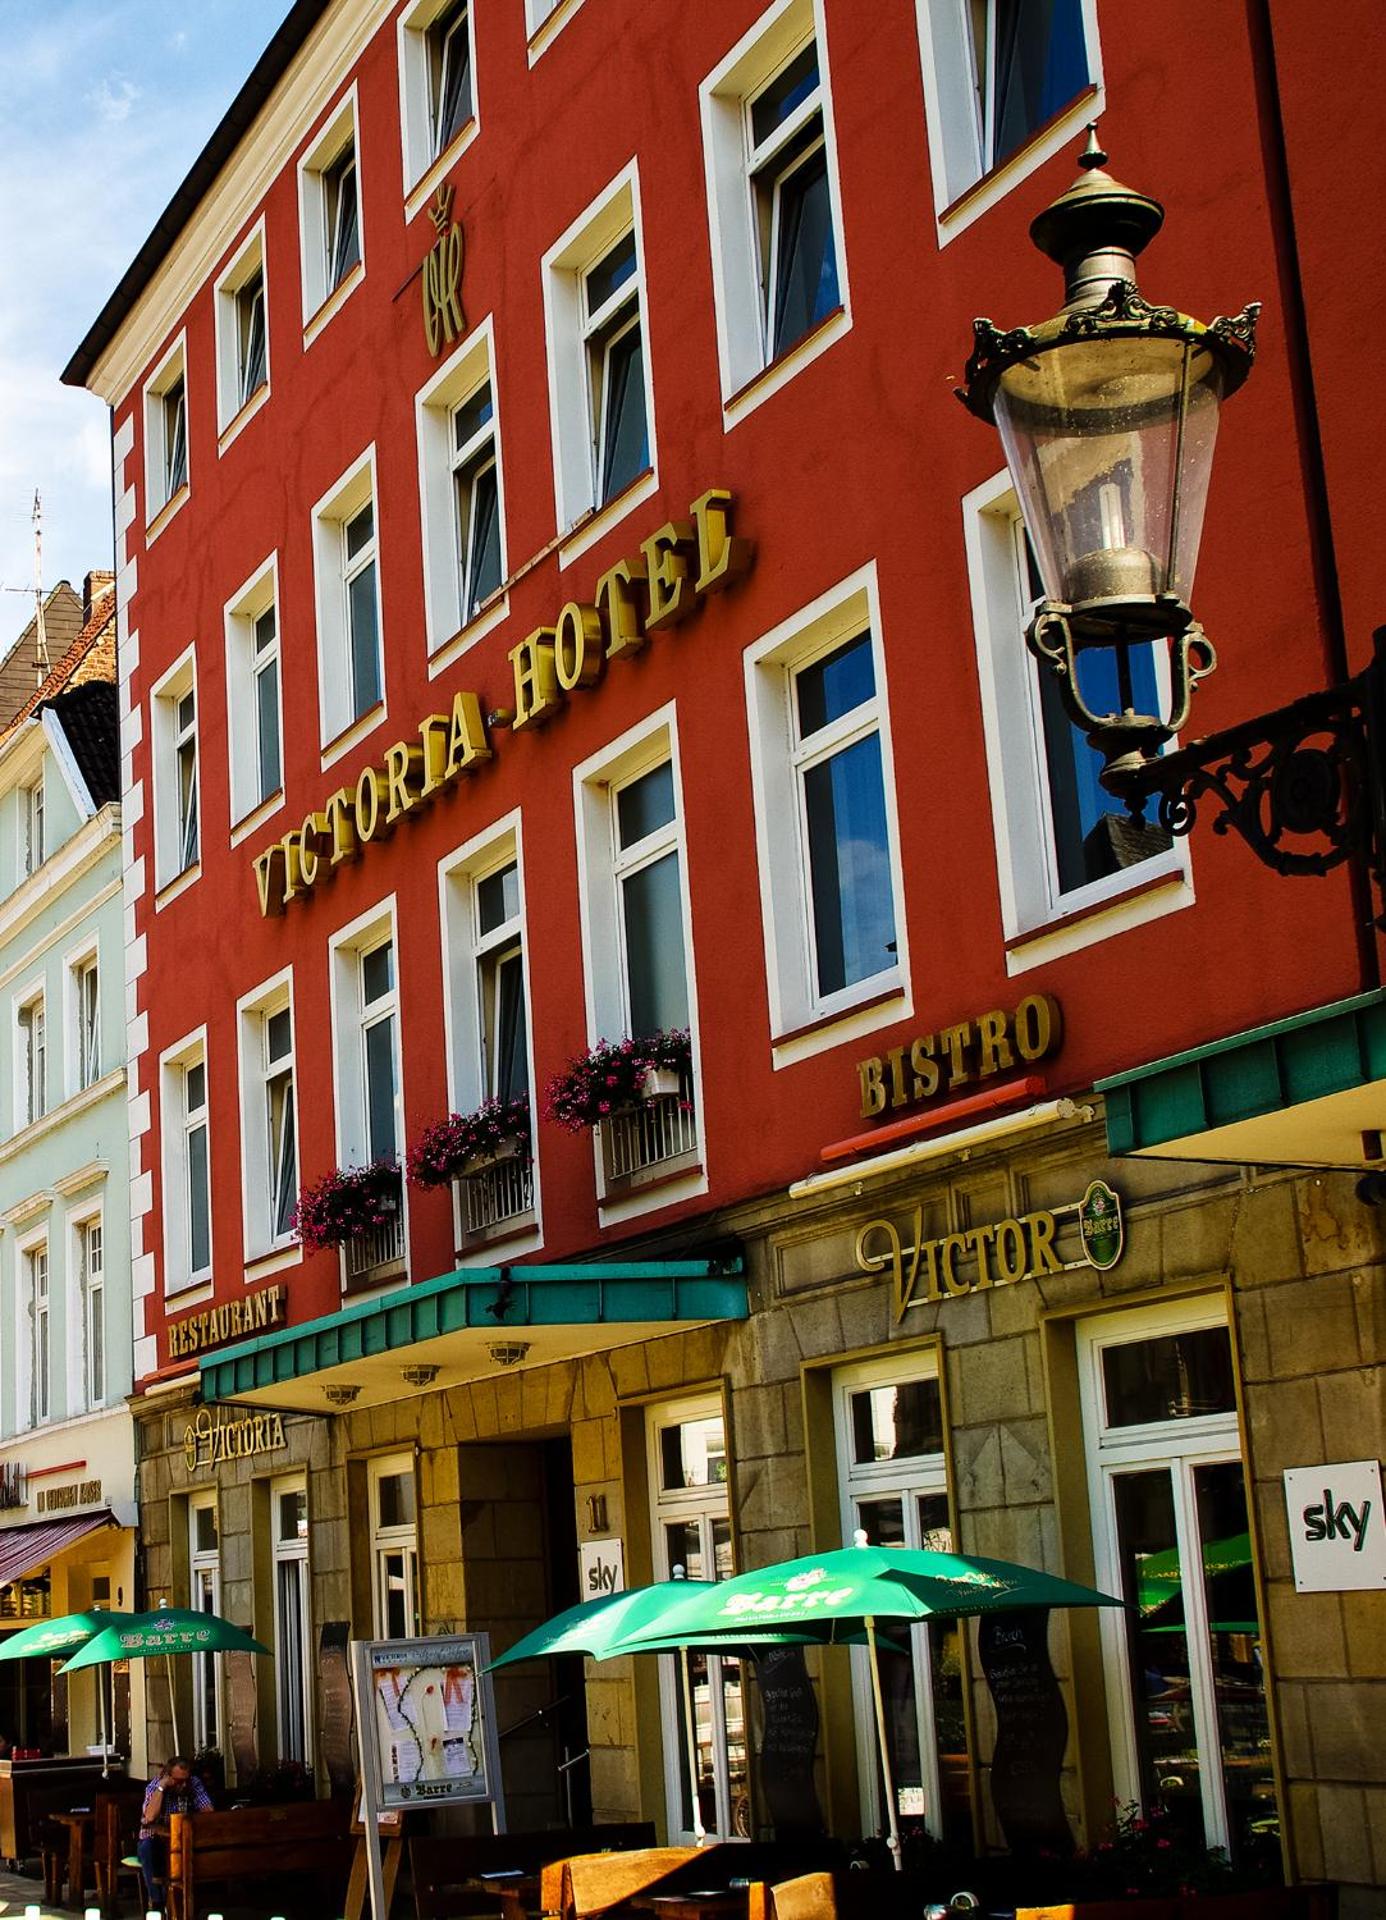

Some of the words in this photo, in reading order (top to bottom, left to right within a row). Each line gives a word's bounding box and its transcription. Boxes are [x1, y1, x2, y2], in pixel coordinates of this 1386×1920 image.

[251, 691, 493, 918] VICTORIA
[506, 489, 748, 732] HOTEL
[855, 993, 1058, 1119] BISTRO
[854, 1205, 1065, 1324] VICTOR
[167, 1284, 283, 1358] RESTAURANT
[195, 1406, 288, 1471] VICTORIA
[585, 1494, 610, 1533] 11
[1302, 1487, 1372, 1552] sky
[588, 1556, 618, 1594] sky
[717, 1587, 854, 1616] Barre
[119, 1629, 211, 1649] Barre
[415, 1782, 453, 1796] Barre
